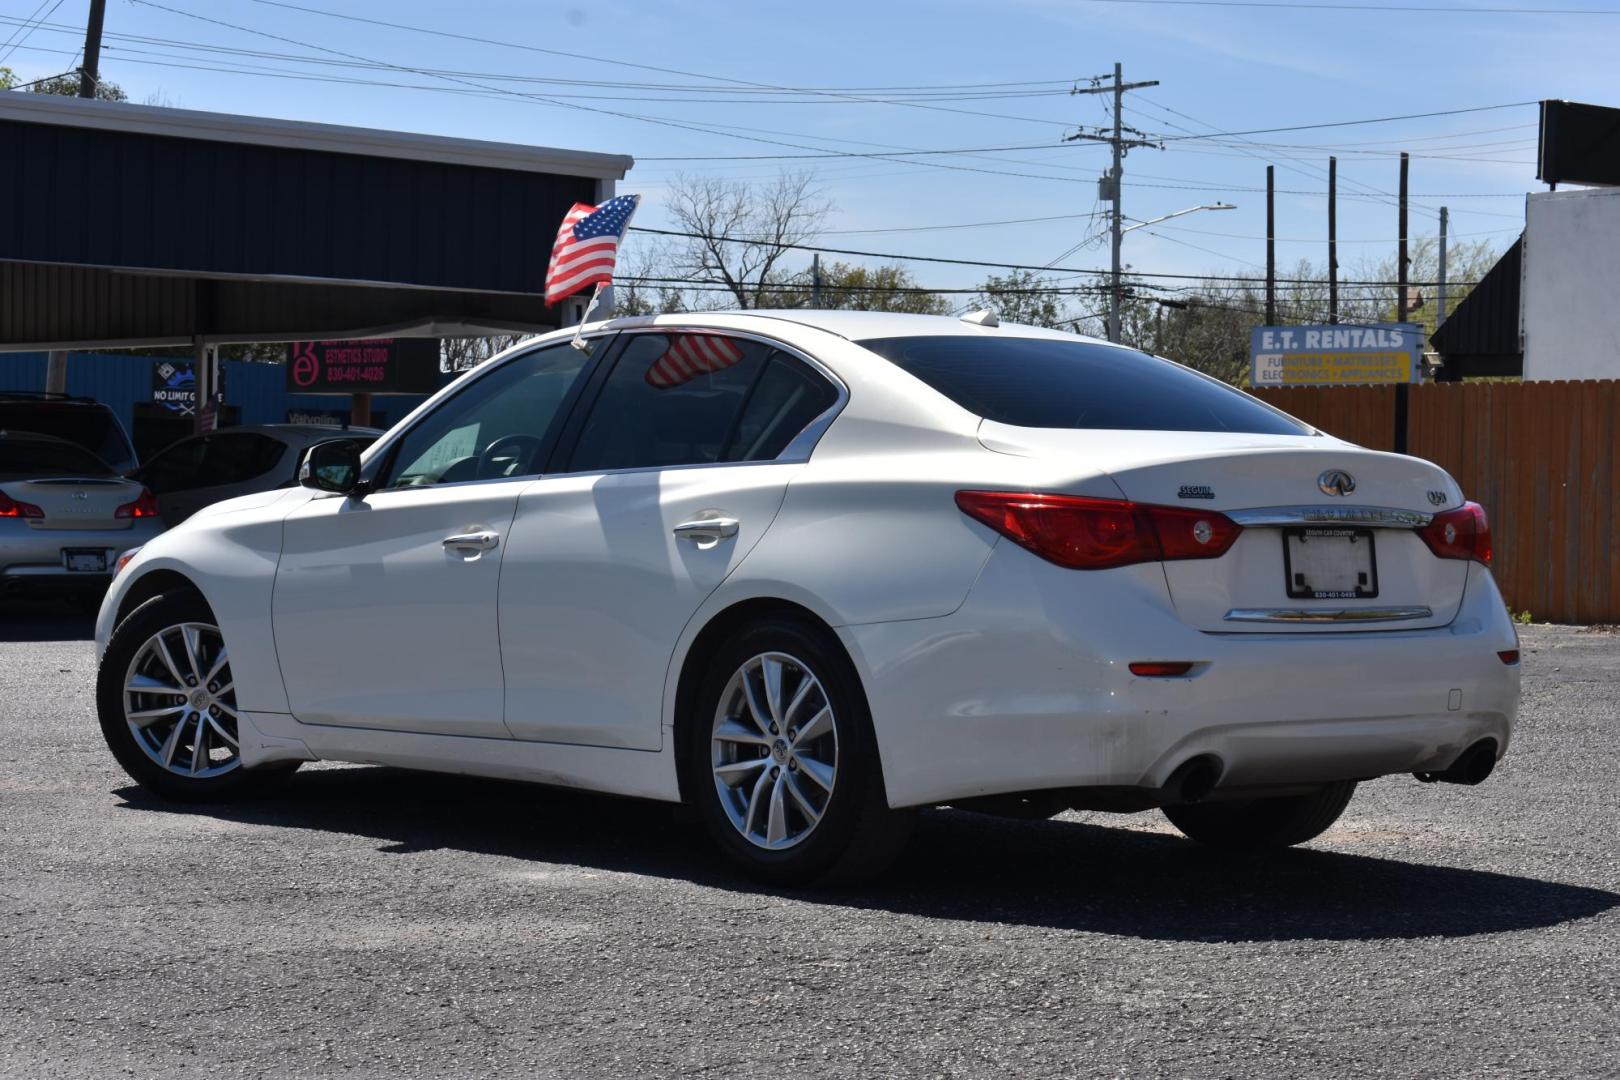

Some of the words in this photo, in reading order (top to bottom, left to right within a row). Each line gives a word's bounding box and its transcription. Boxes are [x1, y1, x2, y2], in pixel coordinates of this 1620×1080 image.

[1262, 331, 1299, 350] E.T.
[1306, 328, 1404, 349] RENTALS
[325, 349, 362, 363] ESTHETICS
[363, 348, 388, 363] STUDIO
[1268, 357, 1323, 368] FURNITURE
[1334, 355, 1398, 367] MATTRESSES
[1262, 369, 1330, 380] ELECTRONICS
[1341, 368, 1403, 380] APPLIANCES
[154, 391, 167, 401] NO
[168, 391, 189, 401] LIMIT
